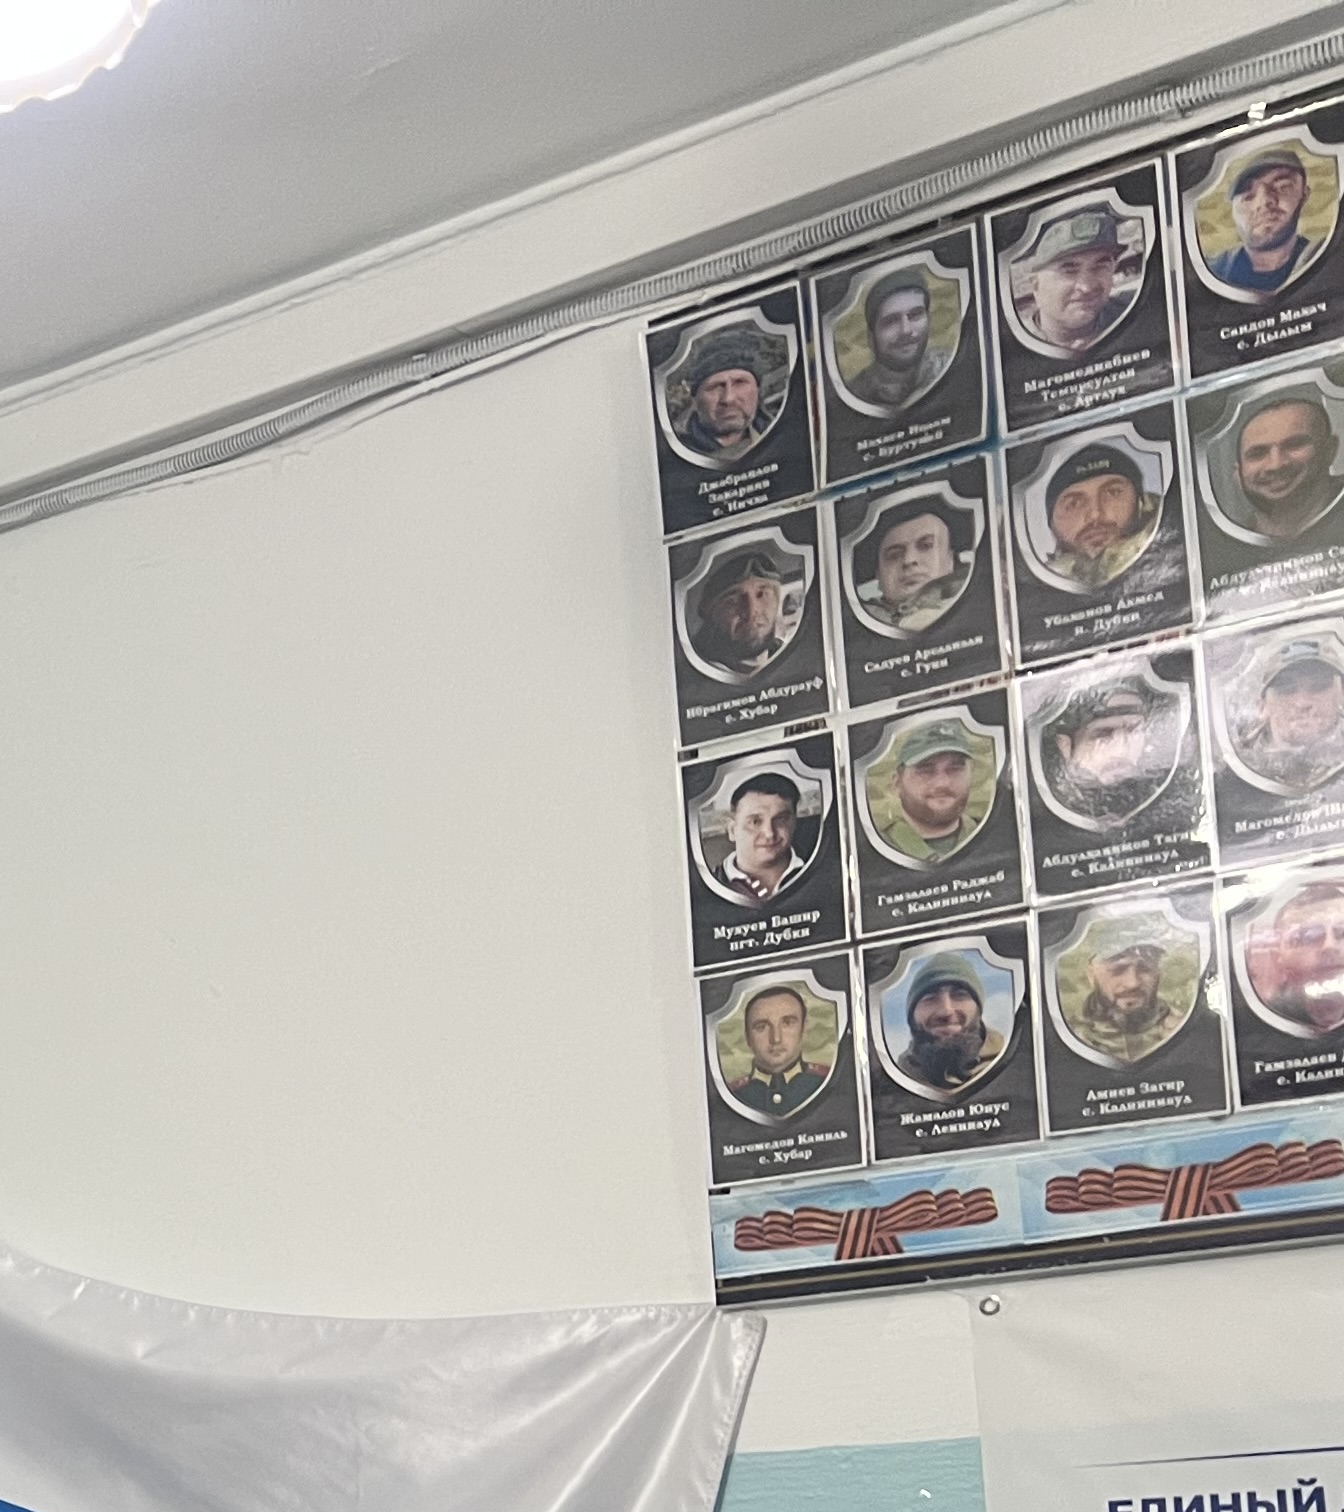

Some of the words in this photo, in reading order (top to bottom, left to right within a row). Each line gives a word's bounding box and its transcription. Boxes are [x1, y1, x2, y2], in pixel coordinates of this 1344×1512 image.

[763, 927, 810, 946] Дубки
[1139, 1080, 1185, 1095] Загир
[969, 1102, 1010, 1116] Юнус
[1099, 1094, 1193, 1115] Калининаул
[931, 1118, 1001, 1136] Ленинаул
[723, 1138, 794, 1156] Магомедов
[798, 1130, 848, 1145] Камиль
[773, 1149, 813, 1164] Хубар
